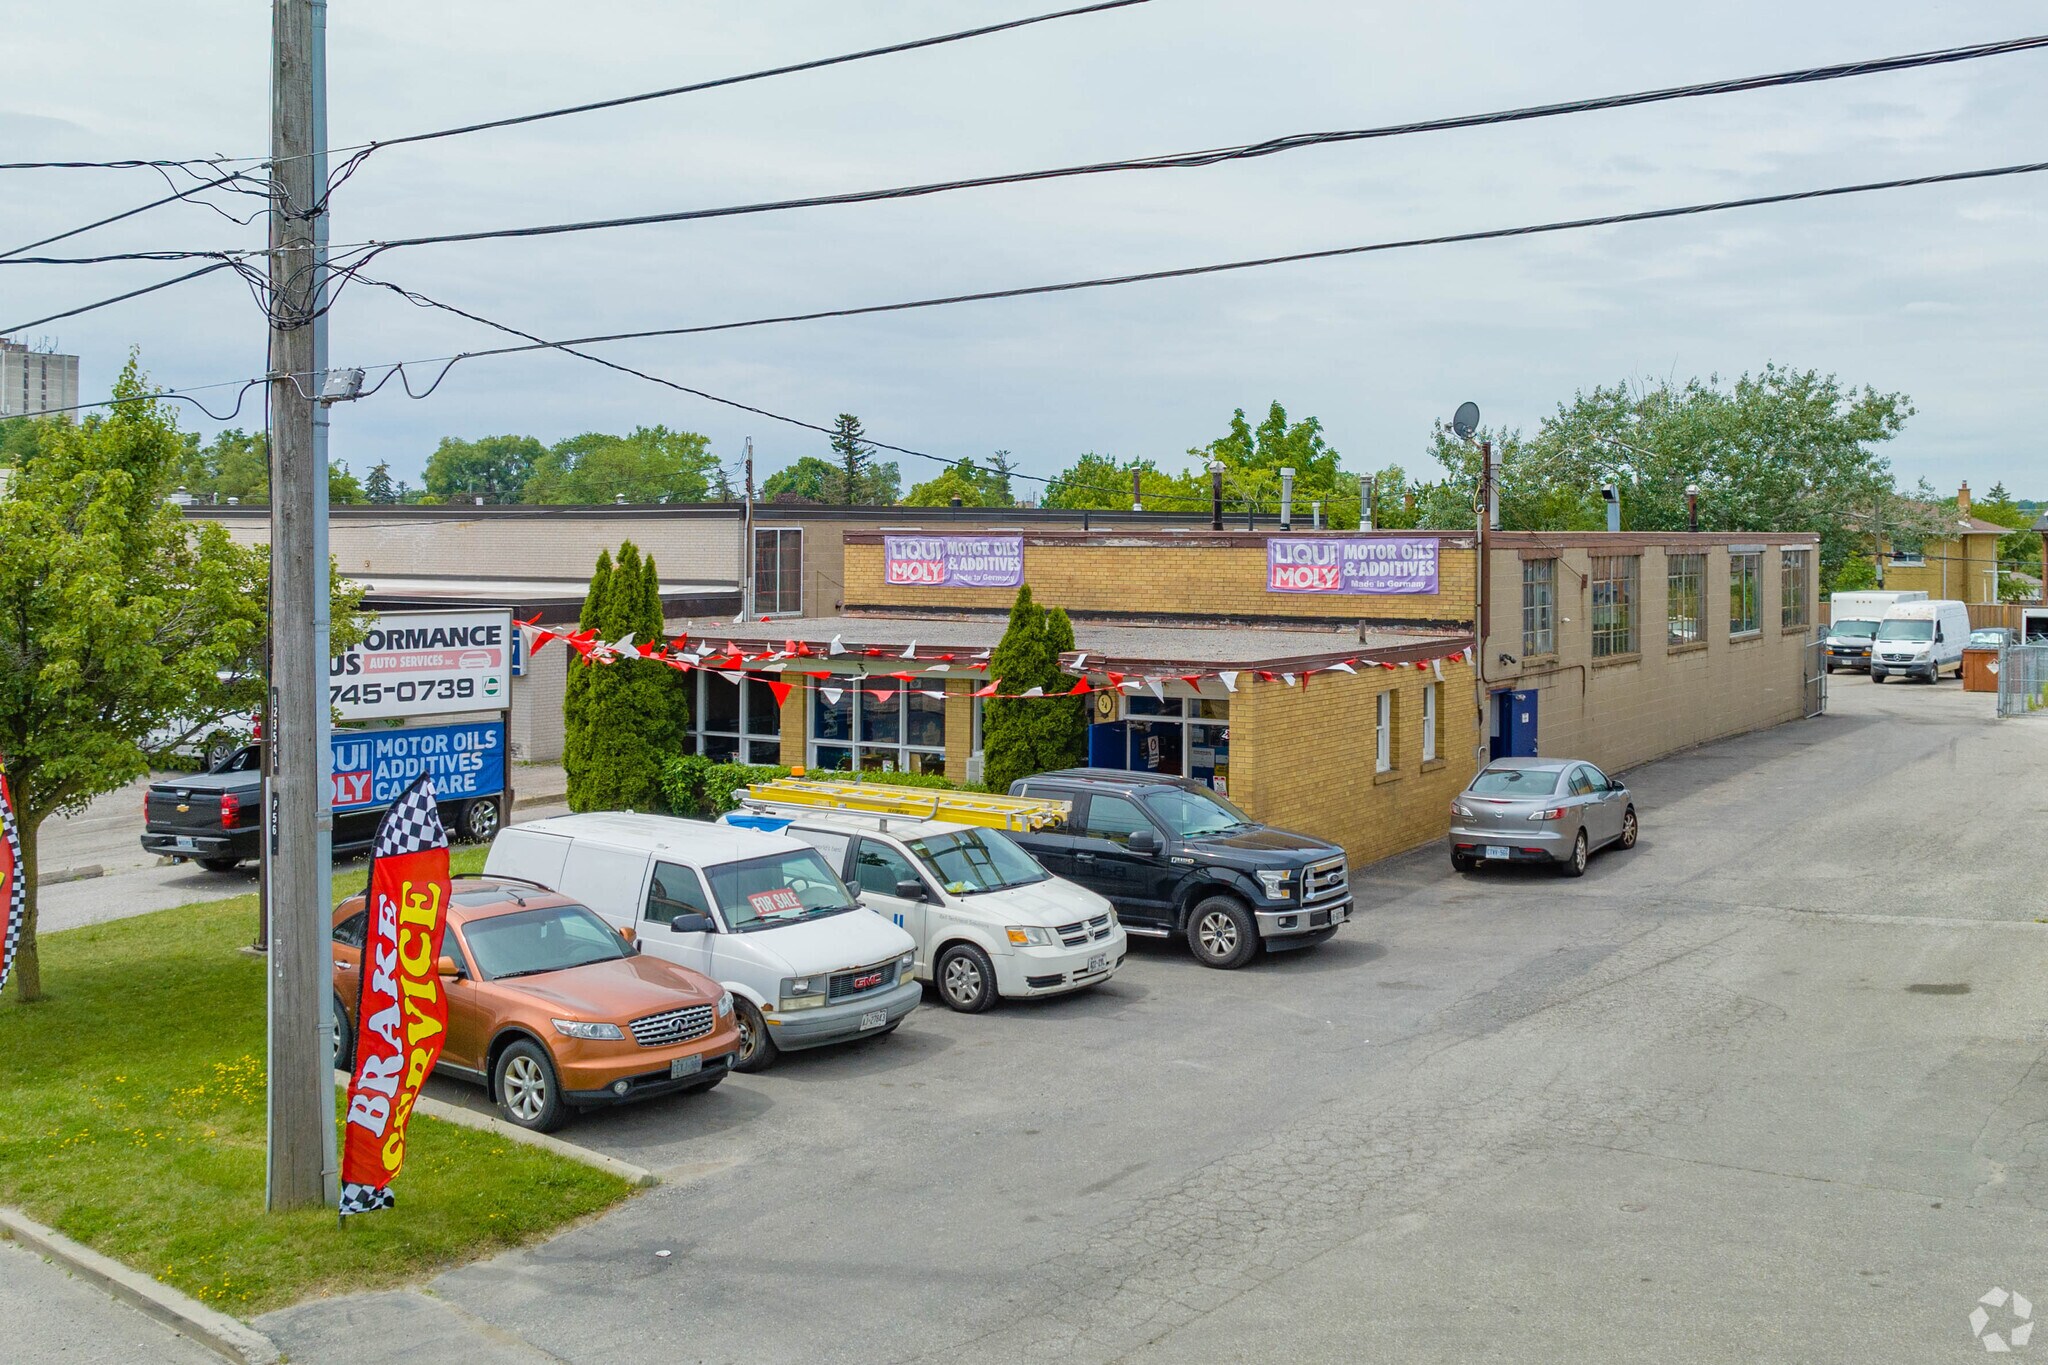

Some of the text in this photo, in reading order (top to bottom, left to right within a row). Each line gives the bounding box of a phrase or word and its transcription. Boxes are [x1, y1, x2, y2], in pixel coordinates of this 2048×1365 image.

[890, 539, 942, 560] LIQUI
[946, 541, 1020, 556] MOTOR OILS
[1275, 543, 1335, 566] LIQUI
[1343, 544, 1435, 560] MOTOR OILS
[891, 561, 943, 582] MOLY
[1275, 567, 1337, 588] MOLY
[1350, 579, 1375, 589] Made
[1387, 579, 1426, 590] Germany
[347, 625, 502, 652] ORMANCE
[369, 656, 397, 669] AUTO
[399, 654, 444, 668] SERVICES
[376, 730, 498, 759] MOTOR OILS
[375, 751, 484, 781] ADDITIVES
[751, 891, 801, 914] FOR SALE
[854, 972, 882, 989] GMC
[347, 893, 404, 1139] BRAKE
